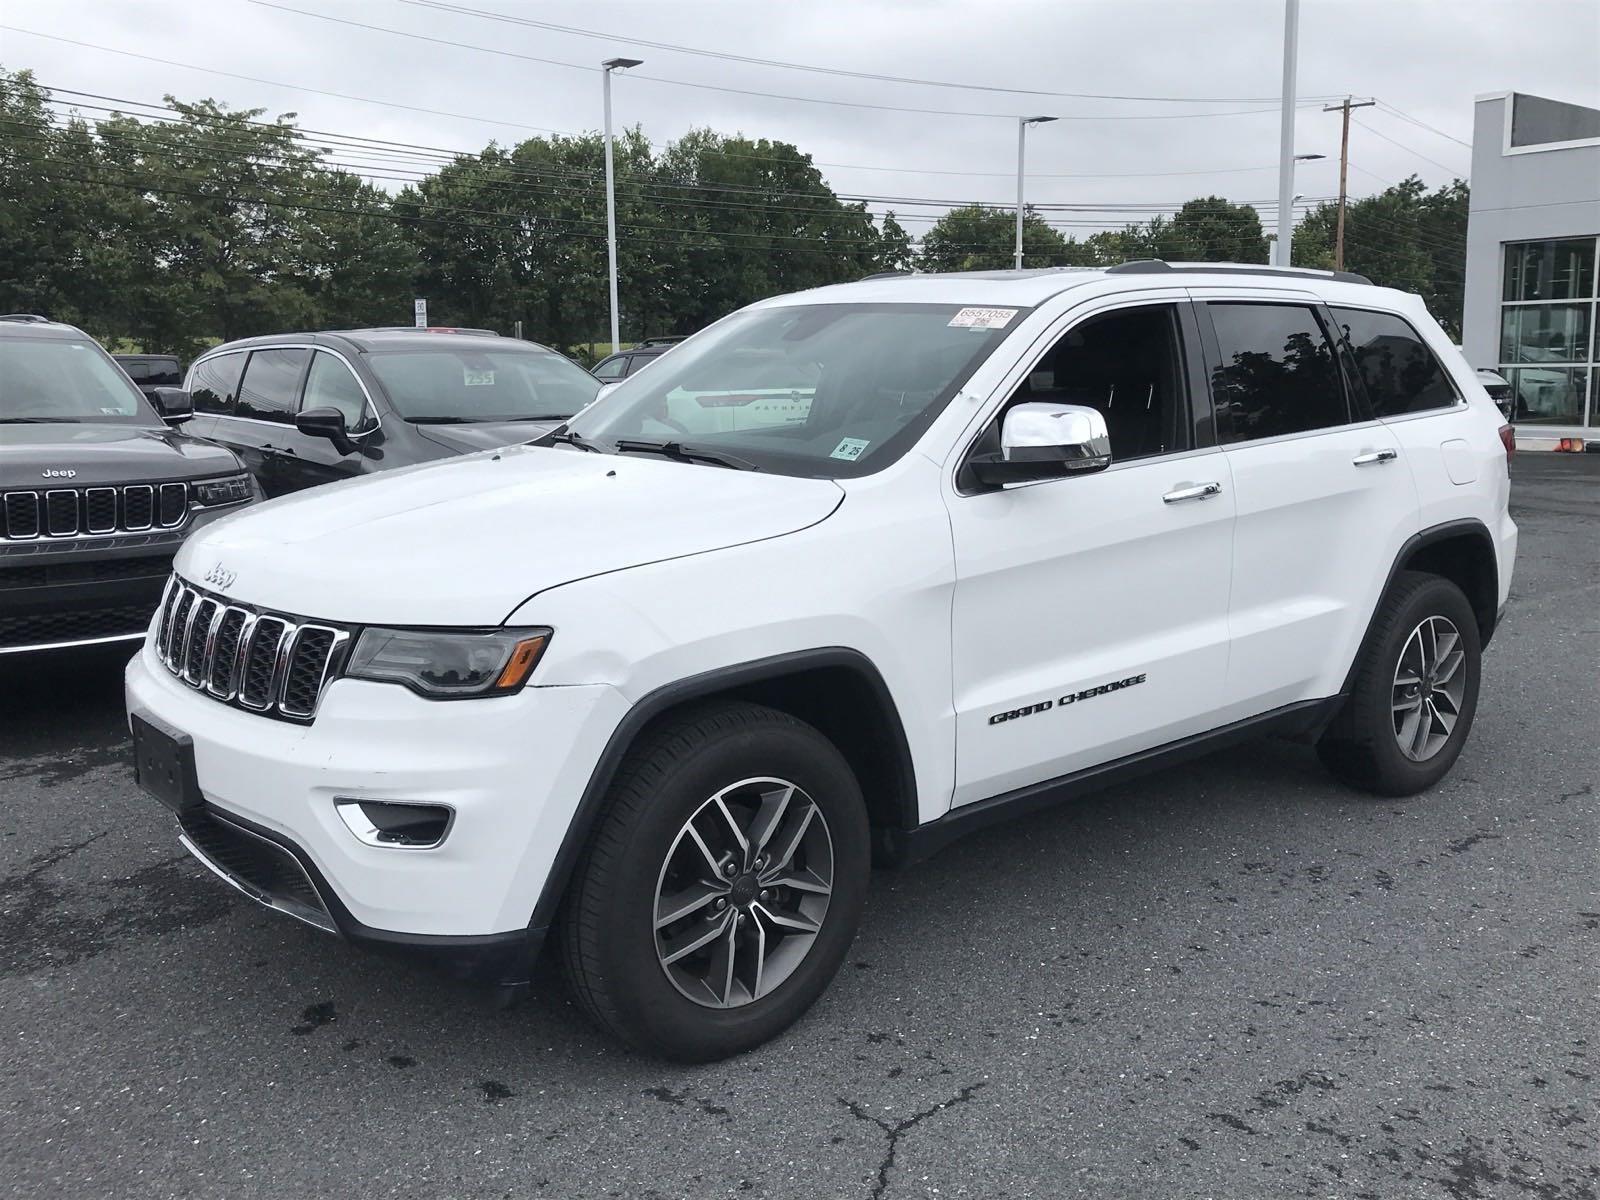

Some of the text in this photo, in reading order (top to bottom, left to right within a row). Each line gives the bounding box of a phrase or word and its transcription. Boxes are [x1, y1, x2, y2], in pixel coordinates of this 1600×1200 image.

[960, 309, 1011, 319] 6557055
[839, 444, 862, 456] 8 25
[42, 469, 76, 479] Jeep
[204, 560, 238, 592] Jeep
[988, 673, 1147, 725] GRAND CHEROKEE
